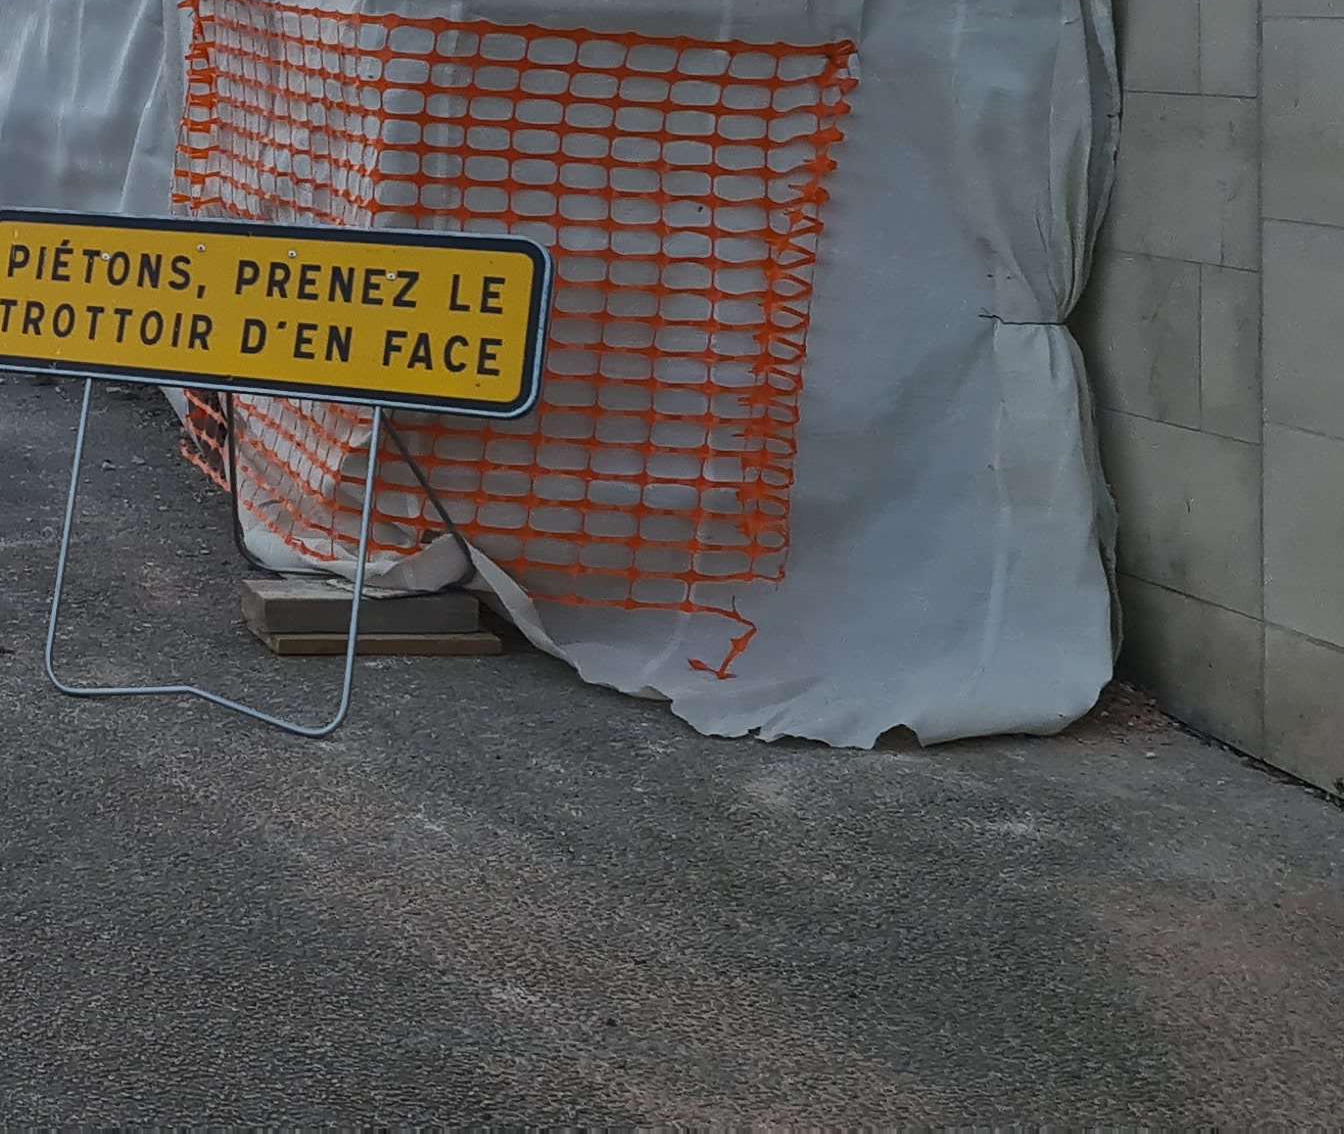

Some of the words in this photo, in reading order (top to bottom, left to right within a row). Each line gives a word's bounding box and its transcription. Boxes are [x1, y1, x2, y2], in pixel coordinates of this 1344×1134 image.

[6, 239, 206, 299] PIÉTONS,
[235, 259, 420, 309] PRENEZ
[448, 273, 506, 315] LE
[0, 298, 214, 351] TROTTOIR
[240, 318, 353, 363] D'EN
[382, 329, 503, 377] FACE
